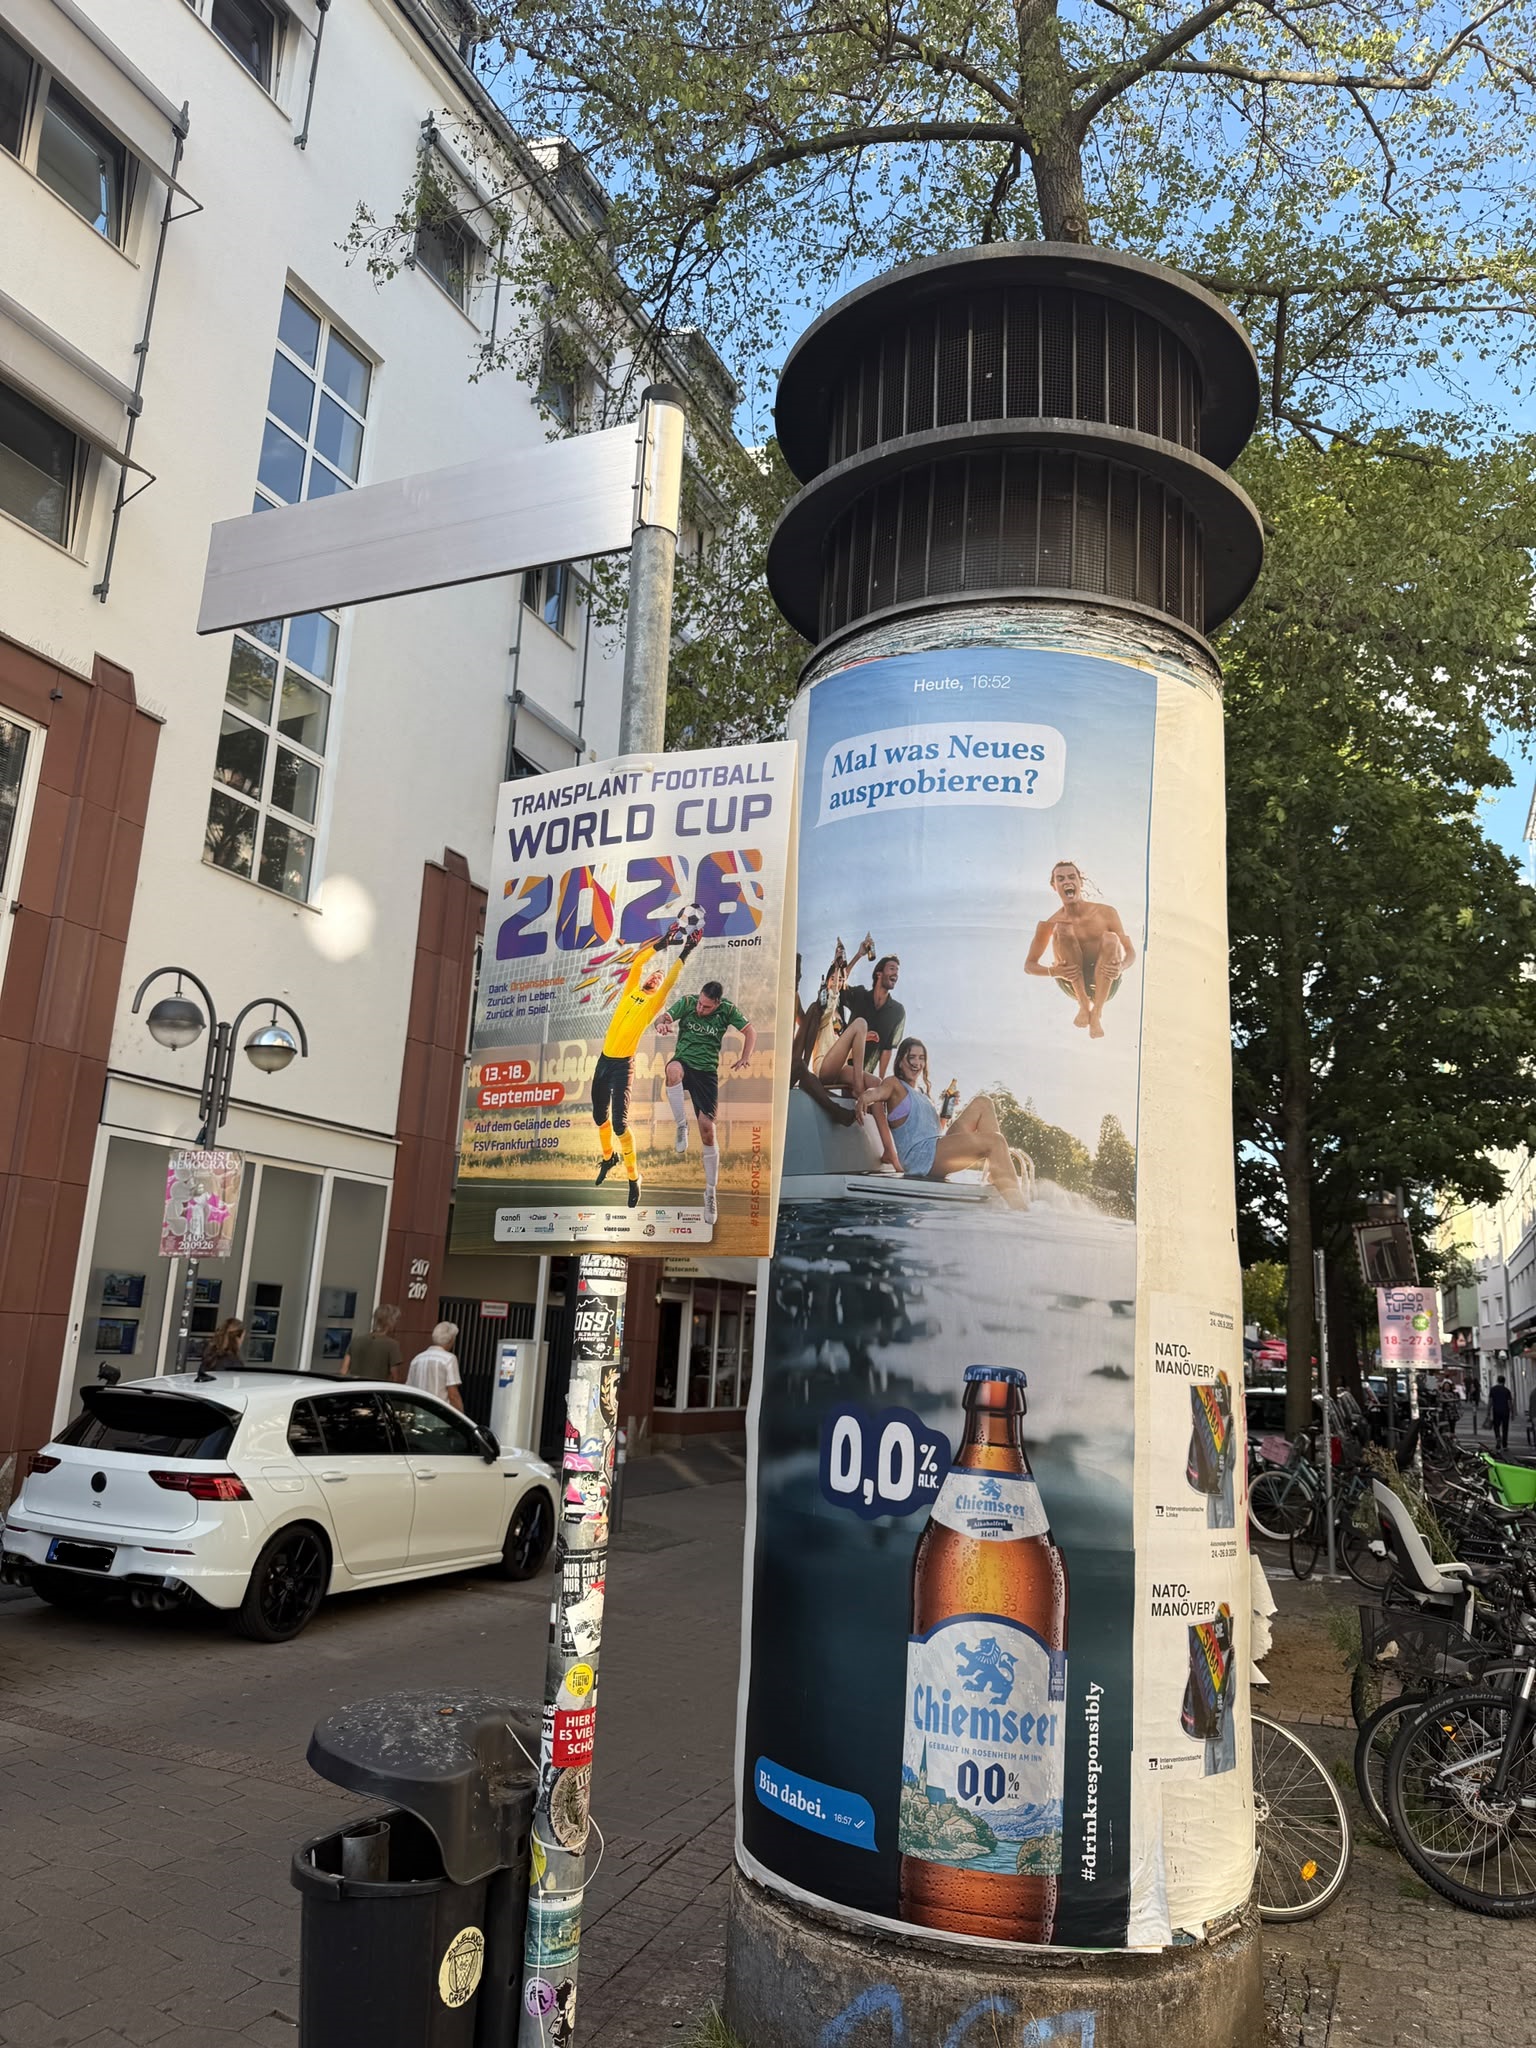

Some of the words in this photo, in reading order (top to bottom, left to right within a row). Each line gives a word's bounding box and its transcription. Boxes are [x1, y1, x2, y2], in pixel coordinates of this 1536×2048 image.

[913, 677, 964, 693] Heute,
[970, 674, 1011, 690] 16:52
[831, 743, 877, 779] Mal
[884, 738, 940, 765] was
[947, 735, 1046, 762] Neues
[512, 773, 643, 818] TRANSPLANT
[651, 762, 775, 793] FOOTBALL
[829, 768, 1039, 810] ausprobieren?
[509, 804, 655, 862] WORLD
[675, 793, 773, 837] CUP
[496, 848, 765, 961] 2026
[727, 935, 762, 948] sanofi
[488, 983, 508, 994] Dank
[510, 976, 566, 992] Organspende
[487, 995, 516, 1007] Zurück
[517, 993, 527, 1003] im
[529, 992, 557, 1002] Leben.
[486, 1008, 514, 1020] Zurück
[516, 1007, 526, 1017] im
[528, 1004, 551, 1016] Spiel.
[485, 1064, 525, 1082] 13.-18.
[482, 1087, 560, 1107] September
[475, 1121, 491, 1133] Auf
[492, 1120, 512, 1132] dem
[513, 1118, 552, 1131] Gelände
[553, 1117, 571, 1129] des
[473, 1141, 490, 1152] FSV
[491, 1138, 535, 1151] Frankfurt
[536, 1137, 559, 1149] 1899
[170, 1160, 240, 1169] DEMOCRACY
[178, 1151, 233, 1161] FEMINIST
[750, 1126, 761, 1227] #REASONTOGIVE
[410, 1258, 430, 1277] 207
[408, 1282, 428, 1300] 209
[1385, 1293, 1424, 1302] FOOD
[575, 1311, 608, 1331] 069
[1155, 1342, 1191, 1358] NATO-
[1155, 1359, 1215, 1378] MANÖVER?
[918, 1473, 940, 1489] ALK.
[955, 1494, 1025, 1517] Chiemseer
[973, 1520, 1006, 1528] Alkoholfrei
[980, 1530, 999, 1538] Hell
[563, 1563, 581, 1578] NUR
[582, 1561, 599, 1577] EINE
[563, 1577, 581, 1593] NUR
[1152, 1584, 1190, 1598] NATO-
[1151, 1599, 1216, 1617] MANÖVER?
[566, 1714, 591, 1727] HIER
[913, 1683, 1058, 1746] Chiemseer
[559, 1729, 573, 1741] ES
[567, 1738, 595, 1755] SCHÖ
[928, 1741, 959, 1753] GEBRAUT
[961, 1747, 970, 1755] IN
[972, 1749, 1017, 1760] ROSENHEIM
[1081, 1681, 1105, 1882] #drinkresponsibly
[759, 1769, 779, 1798] Bin
[780, 1784, 827, 1820] dabei.
[833, 1813, 853, 1826] 16:57
[1007, 1792, 1020, 1800] ALK.
